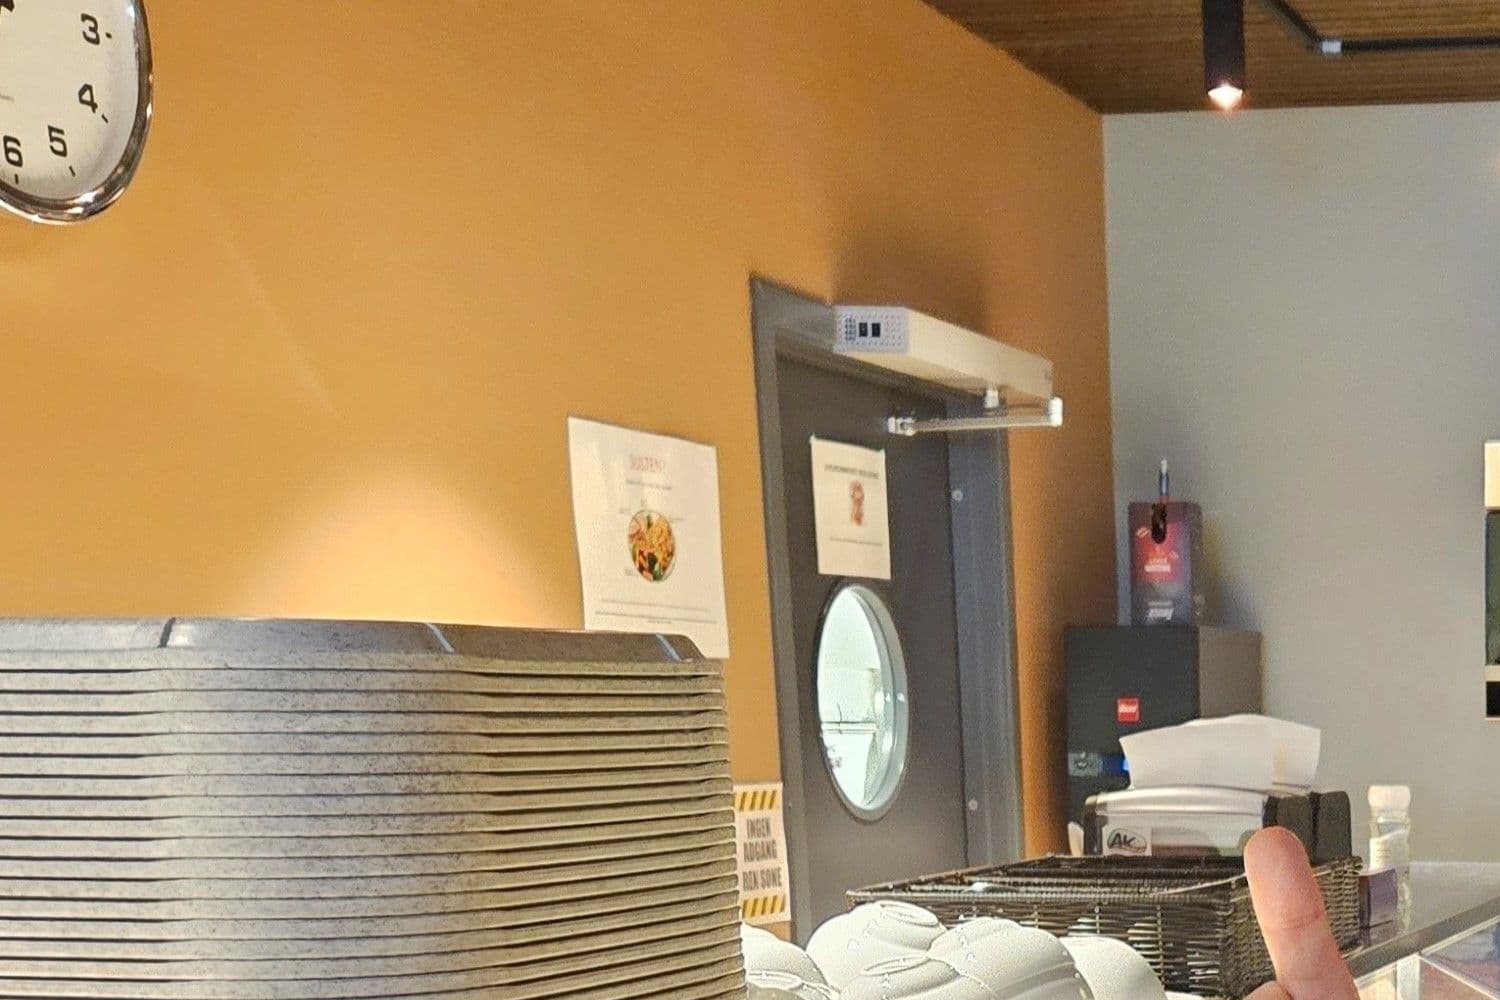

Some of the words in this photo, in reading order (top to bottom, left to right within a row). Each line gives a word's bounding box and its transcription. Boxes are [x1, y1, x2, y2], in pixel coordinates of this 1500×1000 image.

[81, 13, 101, 46] 3
[78, 83, 98, 114] 4
[3, 135, 24, 168] 6
[48, 124, 68, 158] 5
